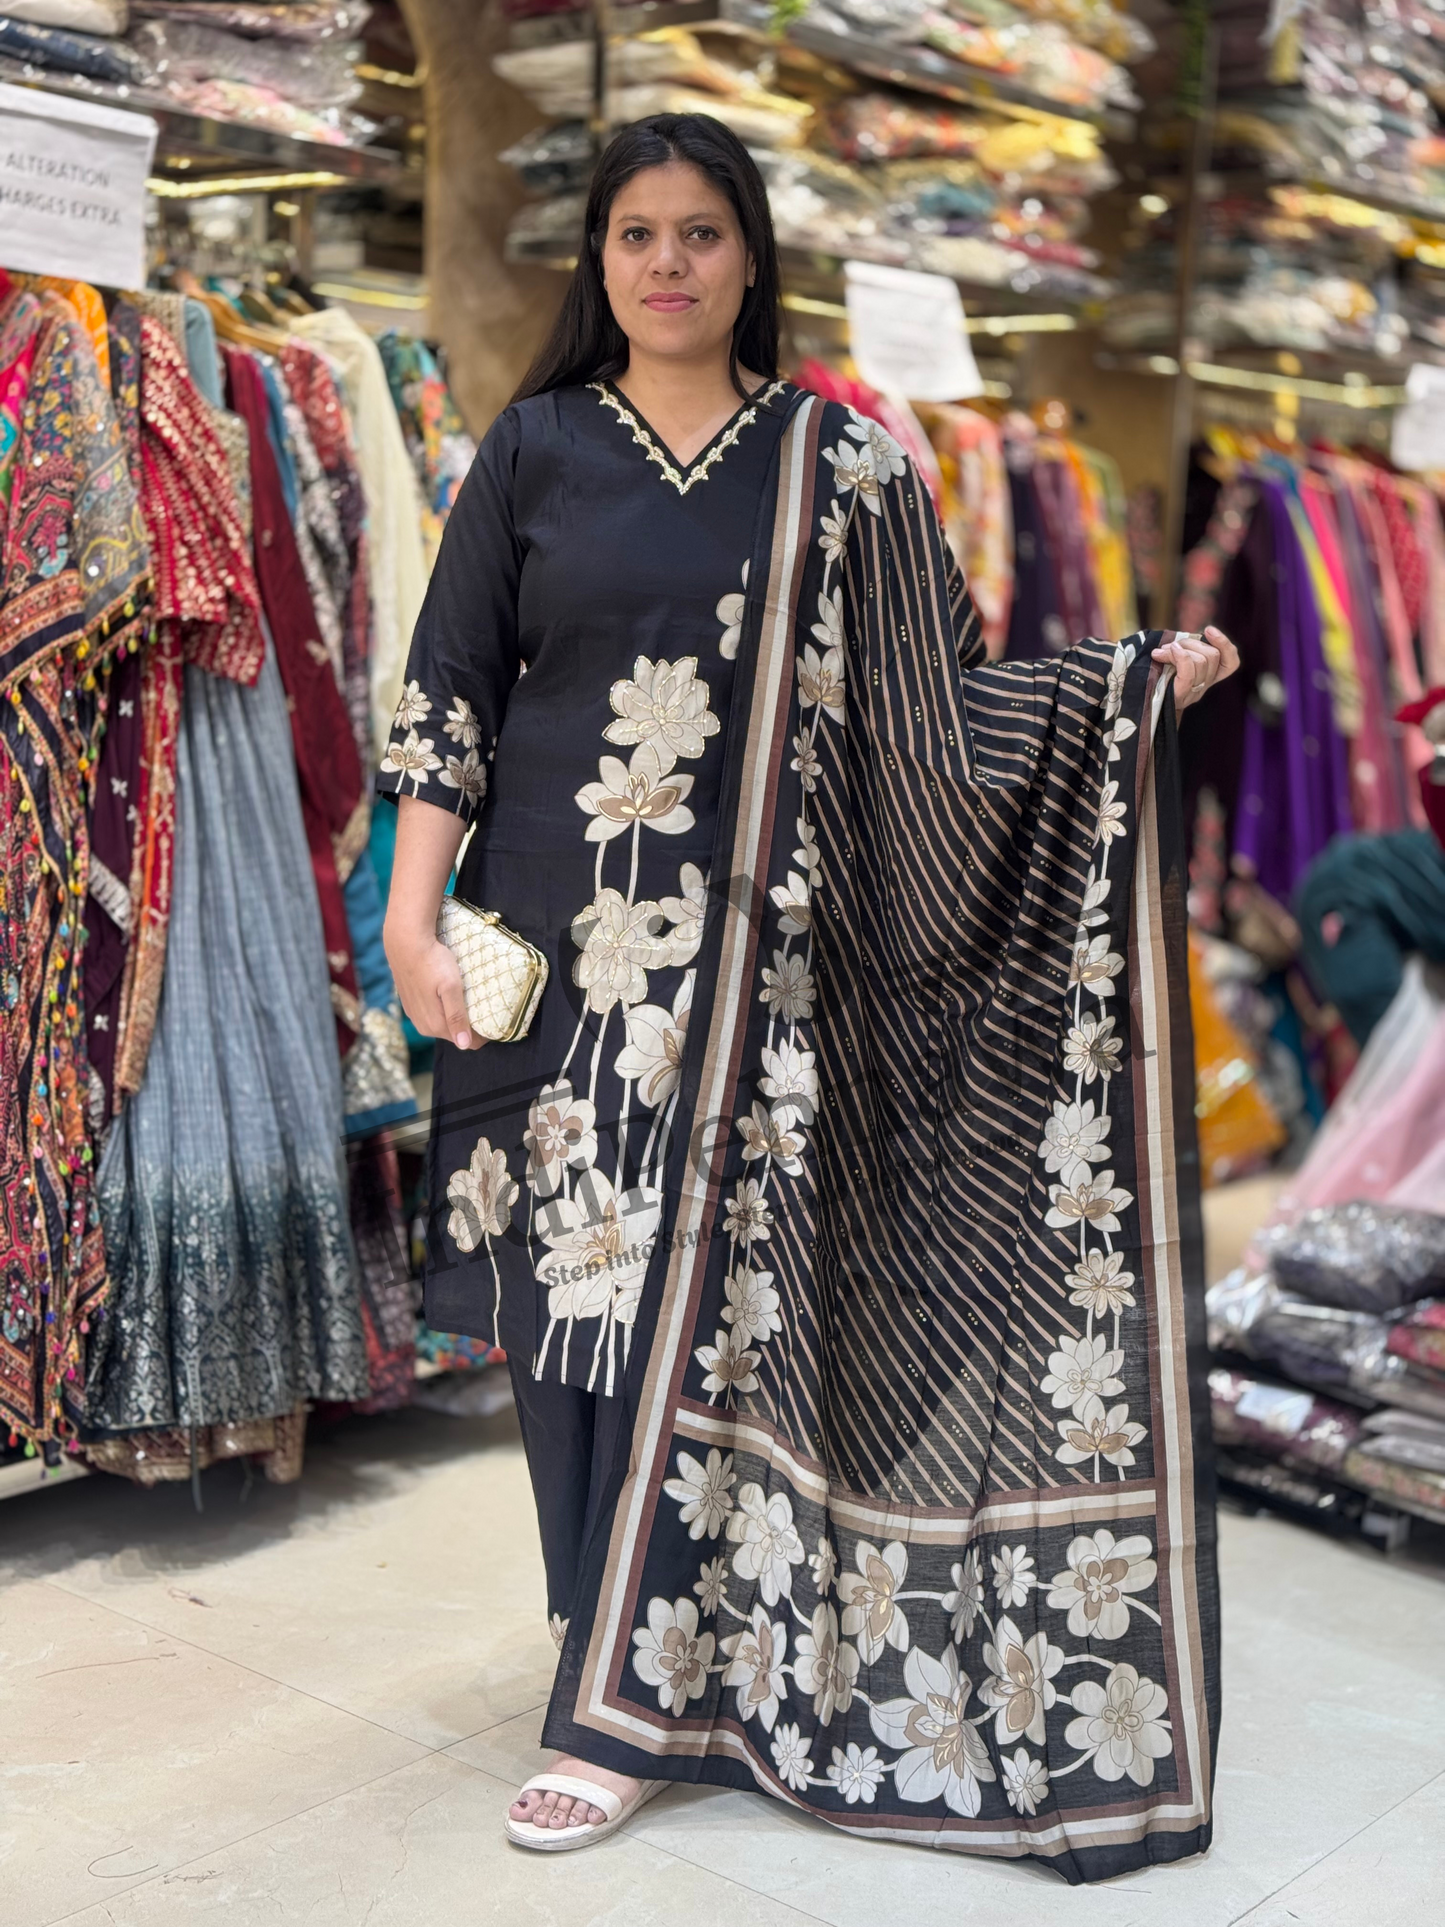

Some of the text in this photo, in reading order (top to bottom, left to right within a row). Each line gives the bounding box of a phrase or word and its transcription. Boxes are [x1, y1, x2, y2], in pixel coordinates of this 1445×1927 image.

[5, 152, 111, 188] ALTERATION
[0, 185, 122, 226] HARGES EXTRA
